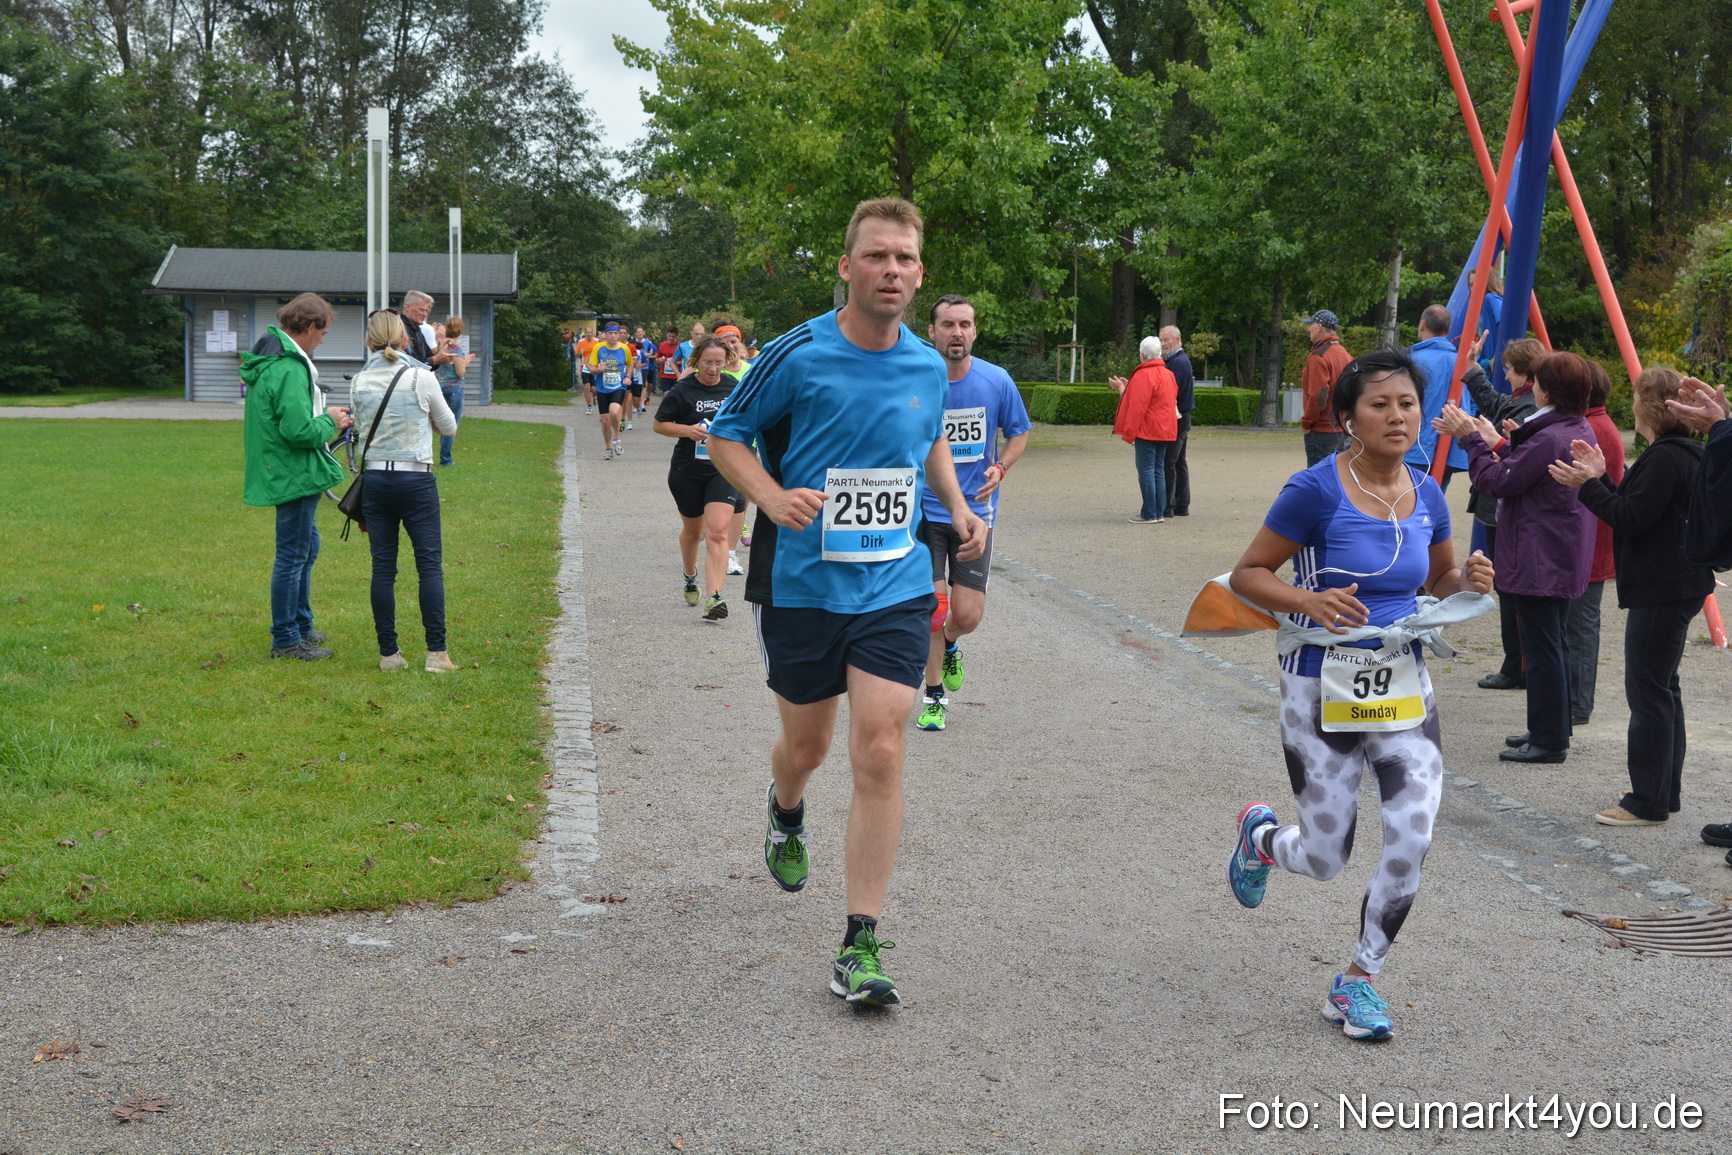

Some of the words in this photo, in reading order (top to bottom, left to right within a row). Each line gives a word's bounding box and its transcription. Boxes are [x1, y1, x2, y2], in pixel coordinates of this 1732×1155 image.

[827, 478, 859, 487] PARTL
[861, 478, 903, 487] Neumarkt
[834, 491, 907, 525] 2595
[861, 535, 884, 549] Dirk
[1327, 652, 1361, 665] PARTL
[1363, 650, 1400, 666] Neumarkt
[1353, 667, 1392, 699] 59
[1351, 705, 1397, 720] Sunday
